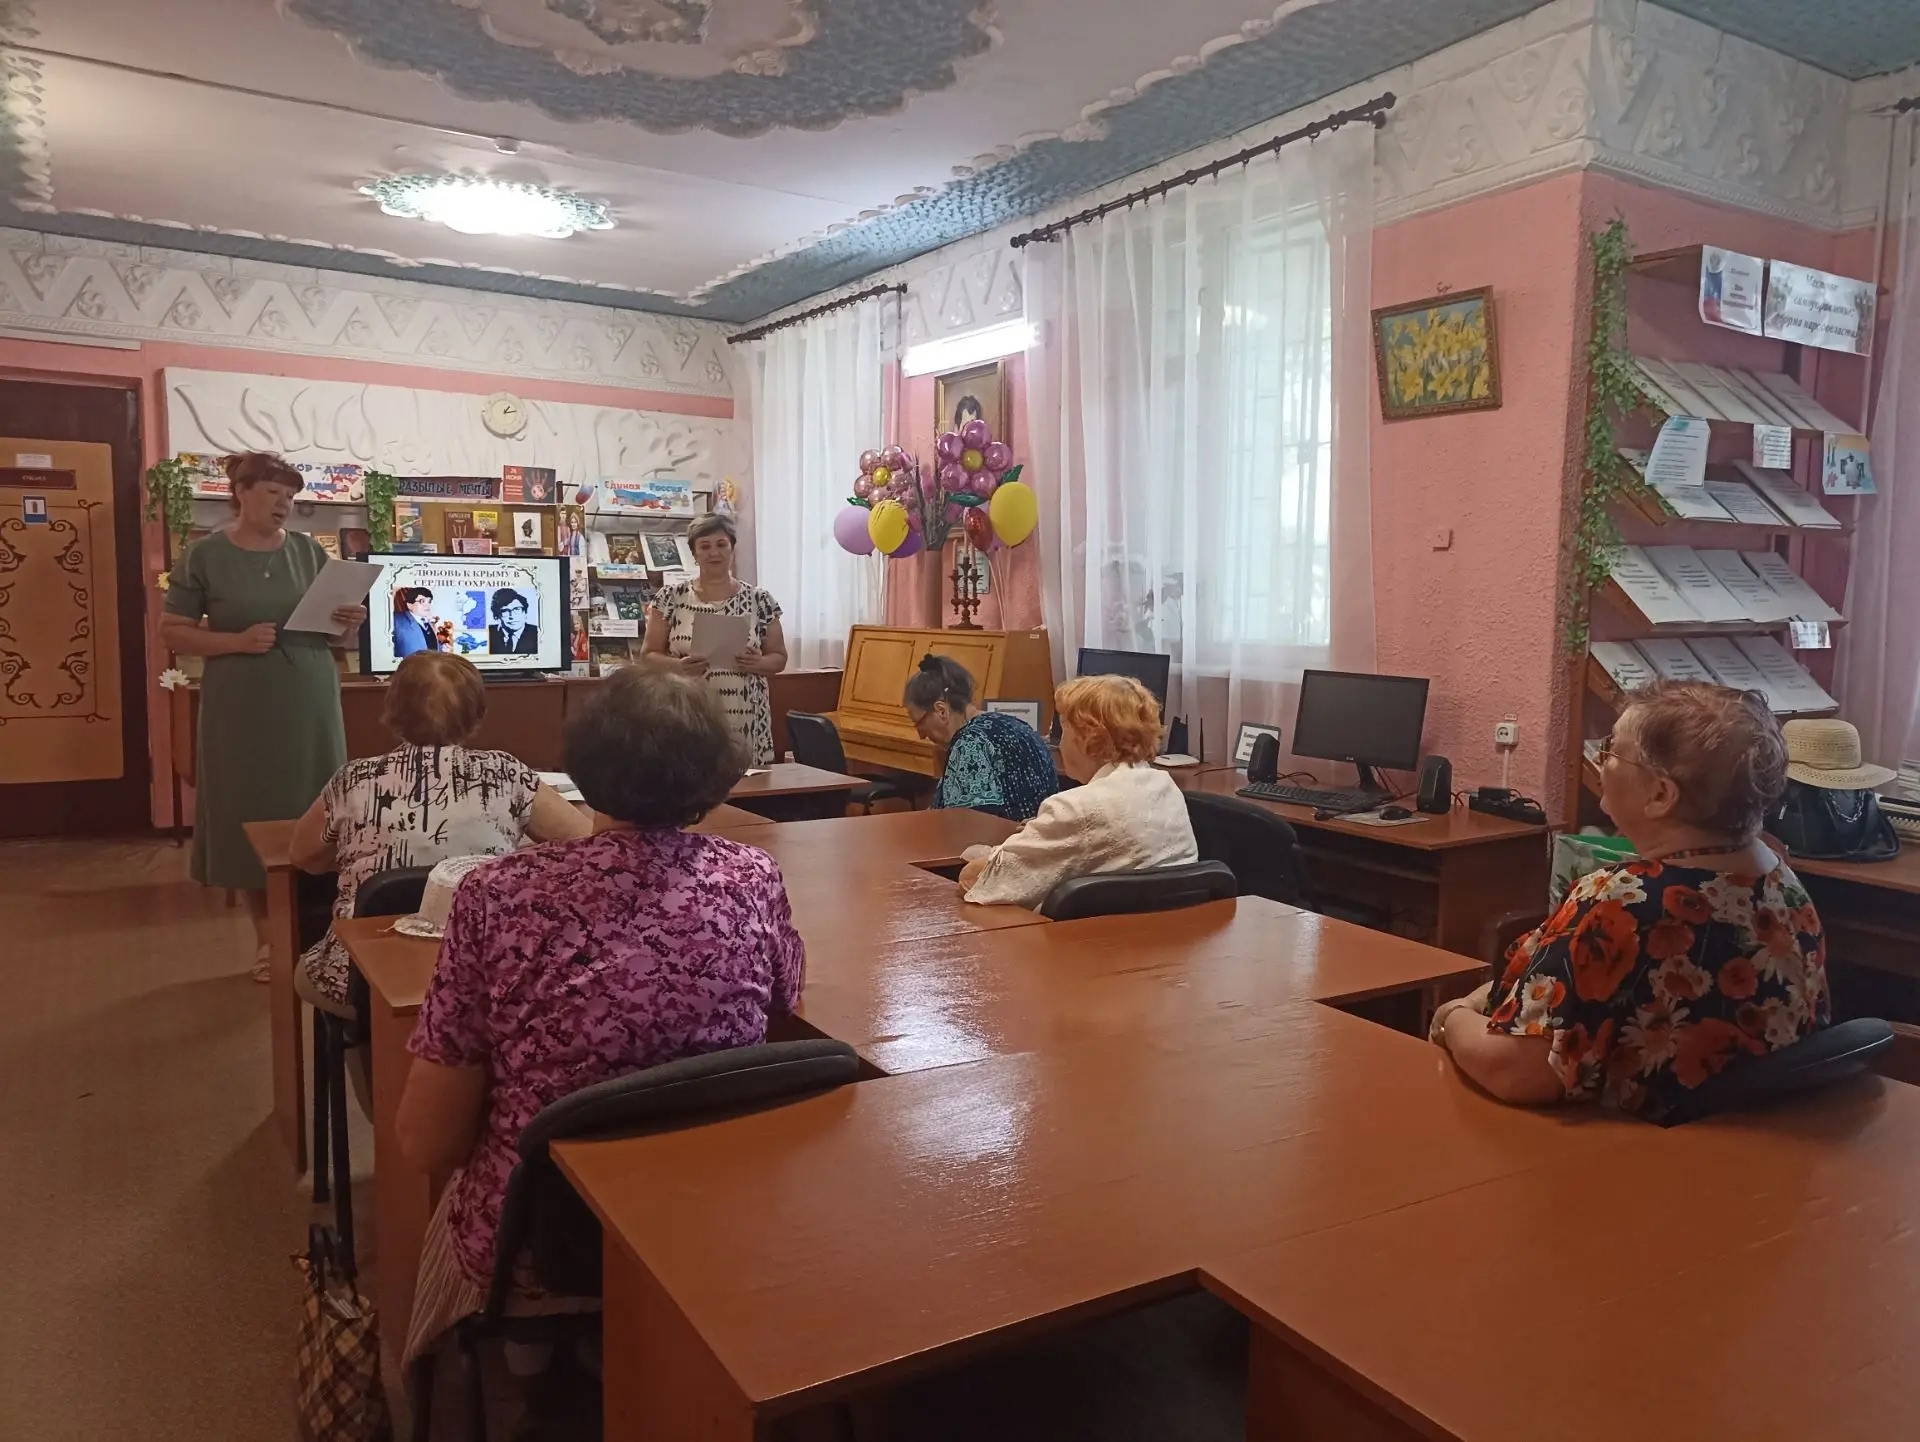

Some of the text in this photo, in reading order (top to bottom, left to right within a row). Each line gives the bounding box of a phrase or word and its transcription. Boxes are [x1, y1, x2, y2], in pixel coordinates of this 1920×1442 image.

[472, 570, 509, 578] КРЫМУ
[513, 570, 520, 578] В
[414, 579, 454, 587] СЕРДЦЕ
